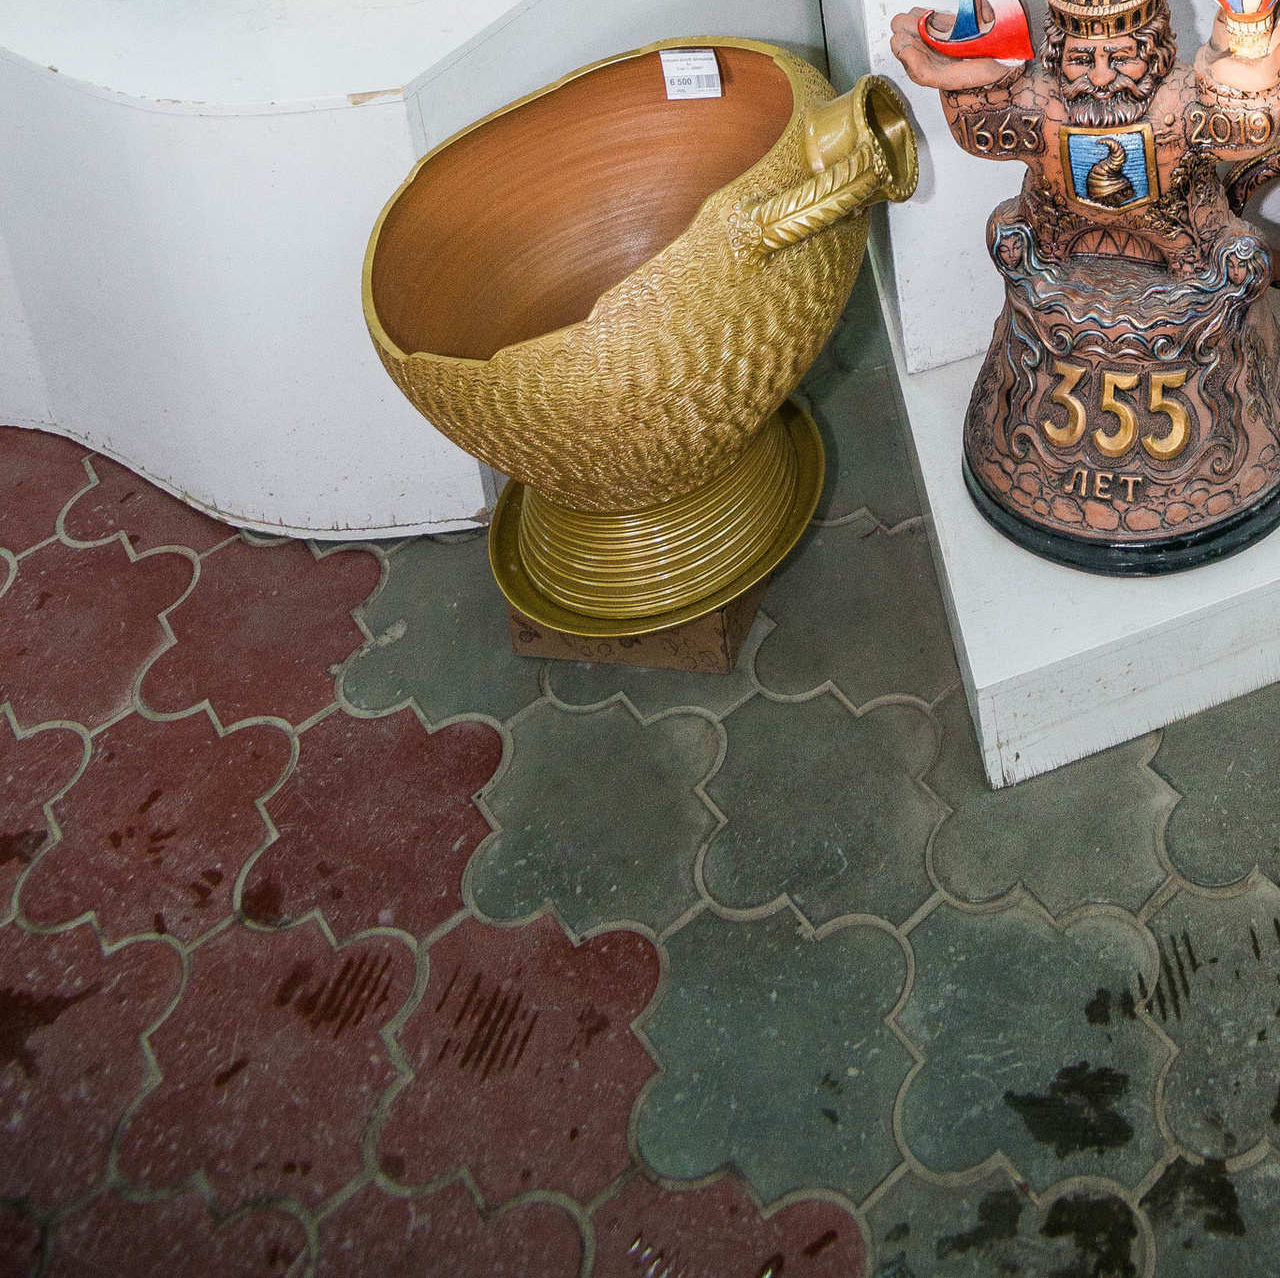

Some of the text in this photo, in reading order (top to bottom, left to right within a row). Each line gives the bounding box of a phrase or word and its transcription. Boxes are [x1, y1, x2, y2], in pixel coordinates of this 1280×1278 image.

[953, 115, 1041, 152] 1663
[1190, 110, 1271, 144] 2019
[1043, 360, 1192, 461] 355
[1064, 469, 1143, 502] ЛЕТ
